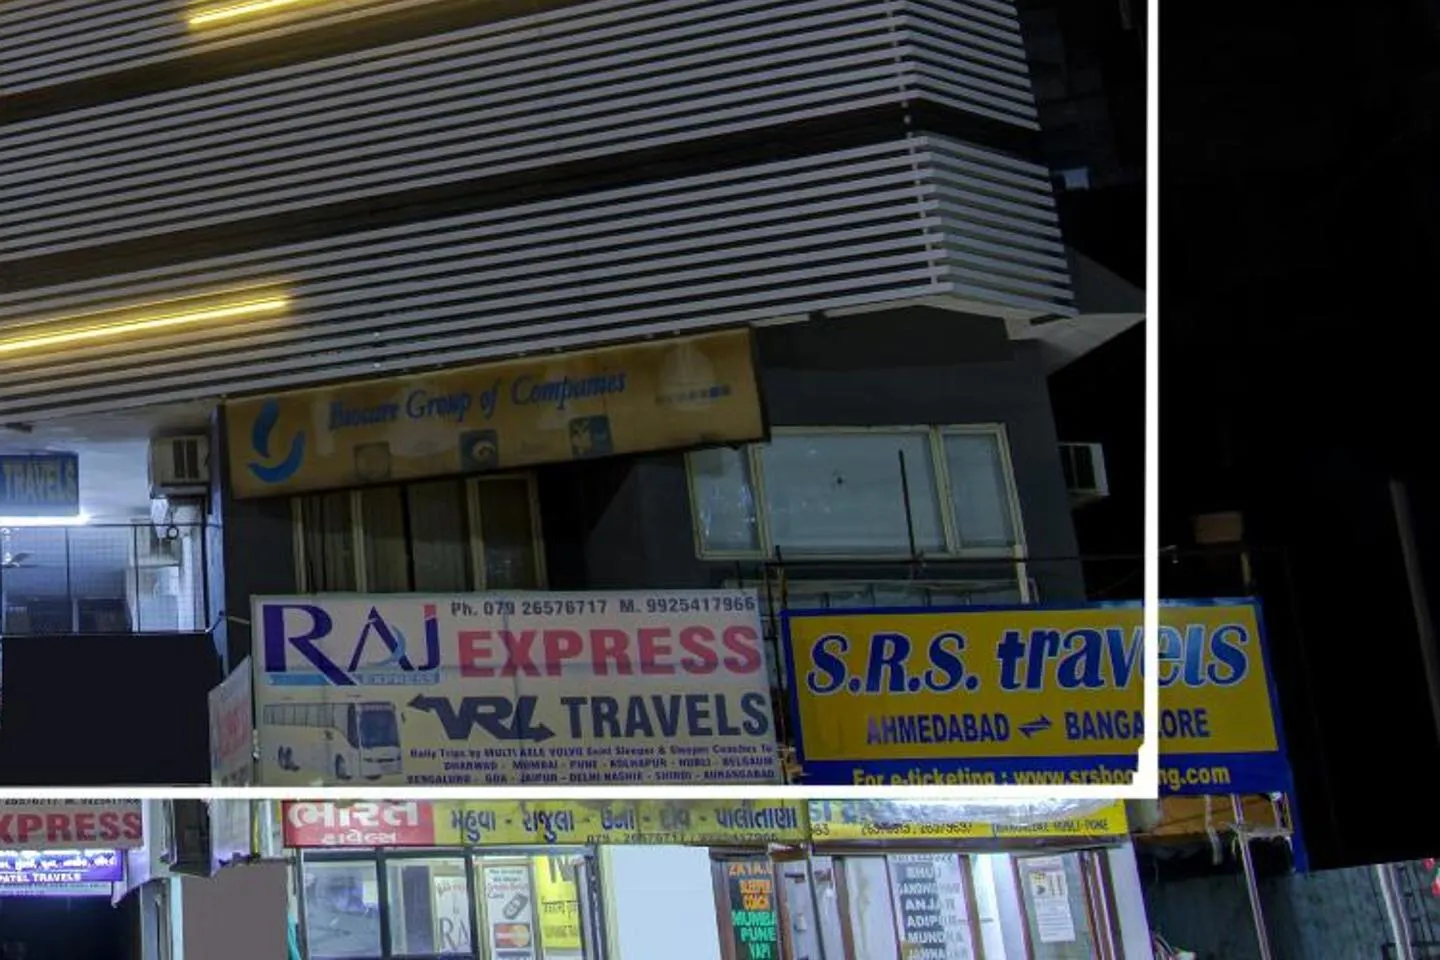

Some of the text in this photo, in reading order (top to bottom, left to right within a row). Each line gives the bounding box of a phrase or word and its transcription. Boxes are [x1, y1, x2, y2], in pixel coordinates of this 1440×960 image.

[406, 390, 471, 423] Group
[480, 377, 501, 420] of
[512, 371, 626, 410] Companies
[4, 459, 78, 502] TRAVELS
[451, 601, 478, 616] Ph.
[483, 600, 516, 616] 079
[619, 599, 641, 614] M.
[262, 604, 762, 686] RAJ EXPRESS
[805, 622, 1250, 696] S.R.S. travels
[407, 692, 769, 741] VRL TRAVELS
[866, 707, 1211, 745] AHMEDABAD BANGAORE
[853, 768, 885, 787] For
[32, 871, 82, 882] TRAVELS
